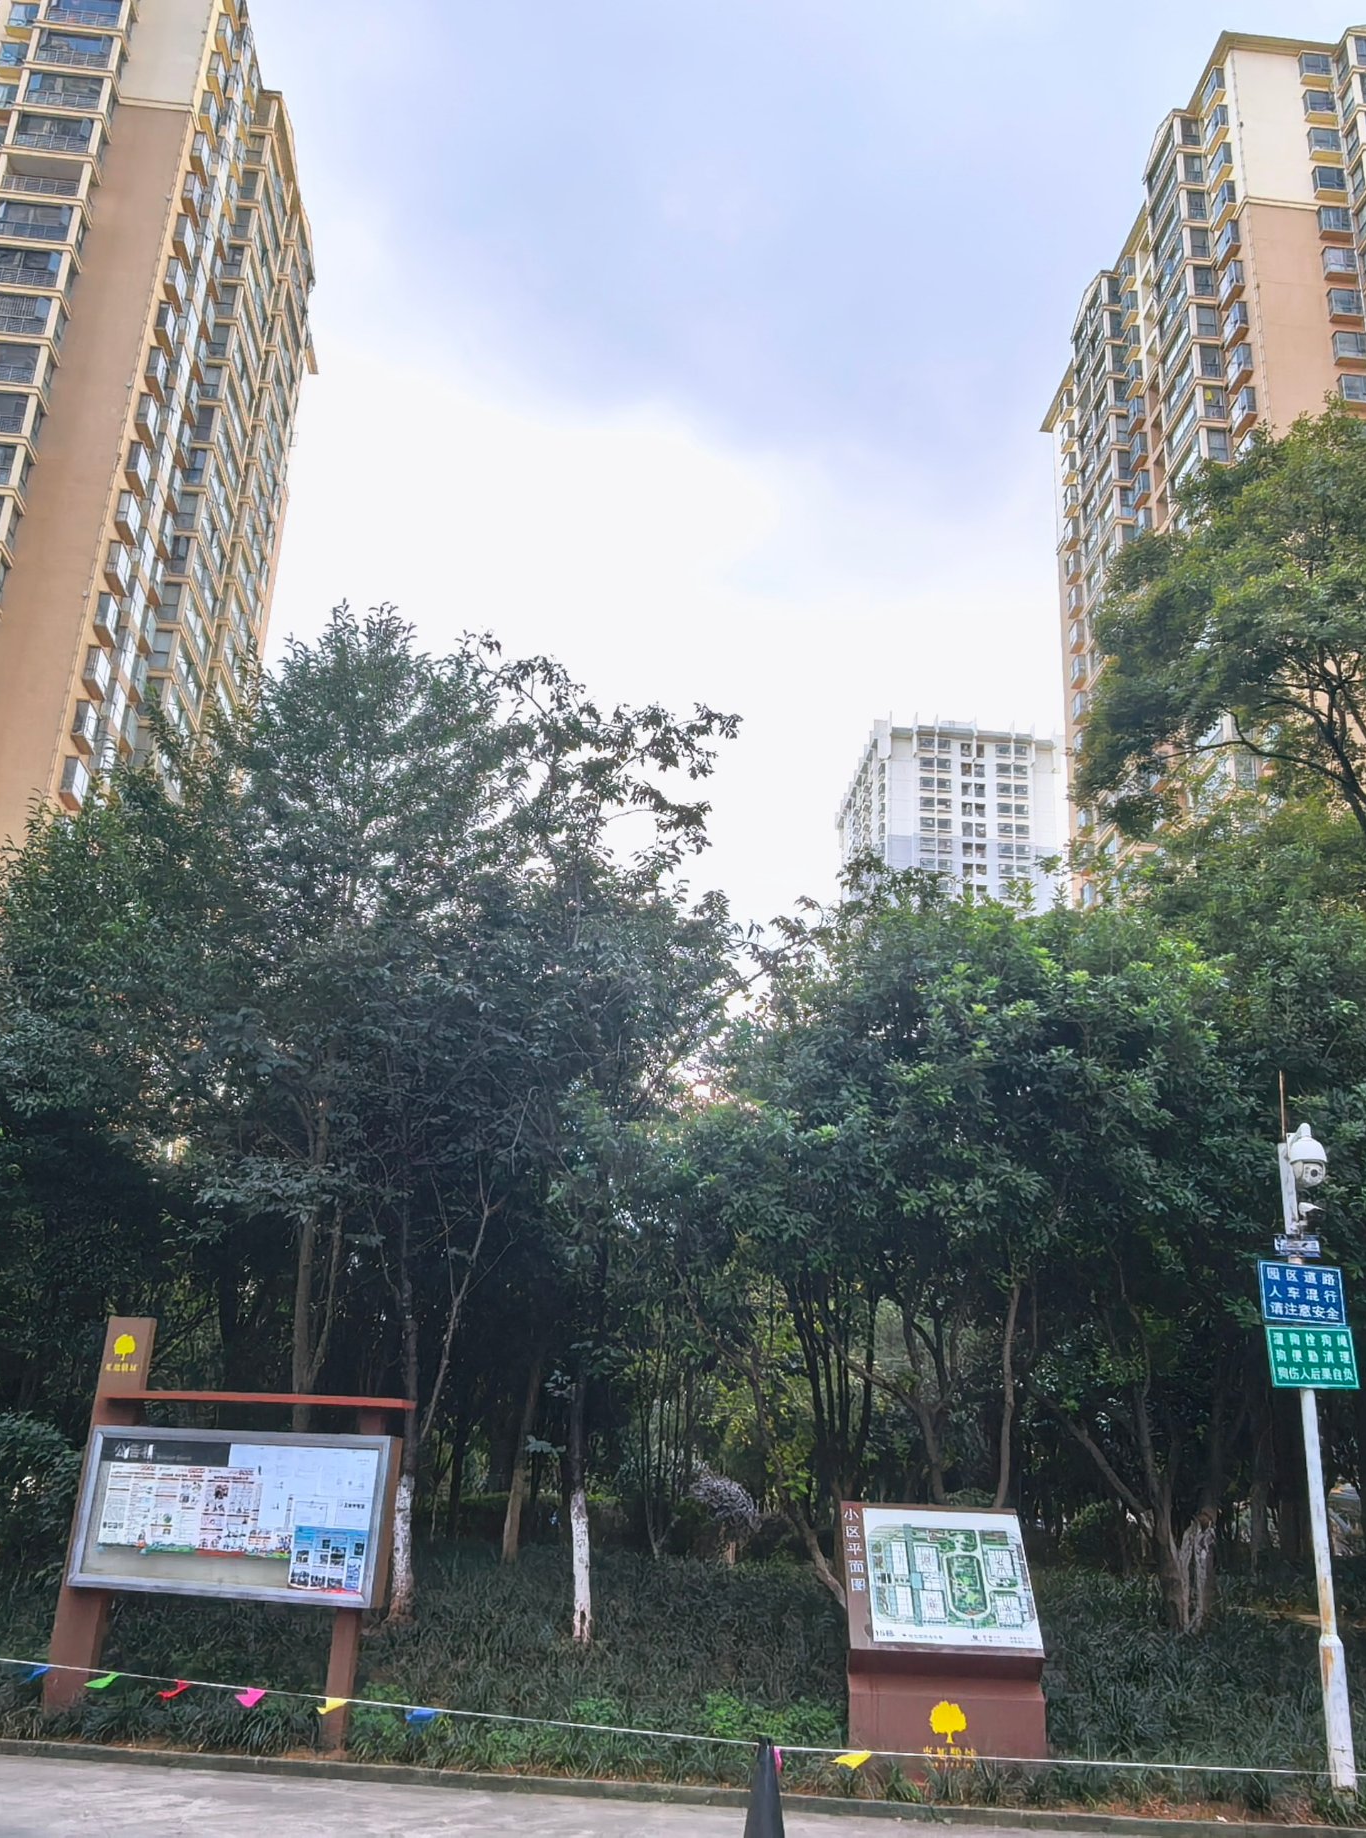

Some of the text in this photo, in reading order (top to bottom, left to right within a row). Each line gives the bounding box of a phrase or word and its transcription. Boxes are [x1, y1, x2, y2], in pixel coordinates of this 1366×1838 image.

[1266, 1266, 1336, 1286] 园区道路
[1269, 1285, 1338, 1303] 人车混行
[1269, 1301, 1340, 1320] 请注意安全
[1277, 1366, 1354, 1381] 狗伤人后果自负
[843, 1507, 866, 1592] 小区平面图
